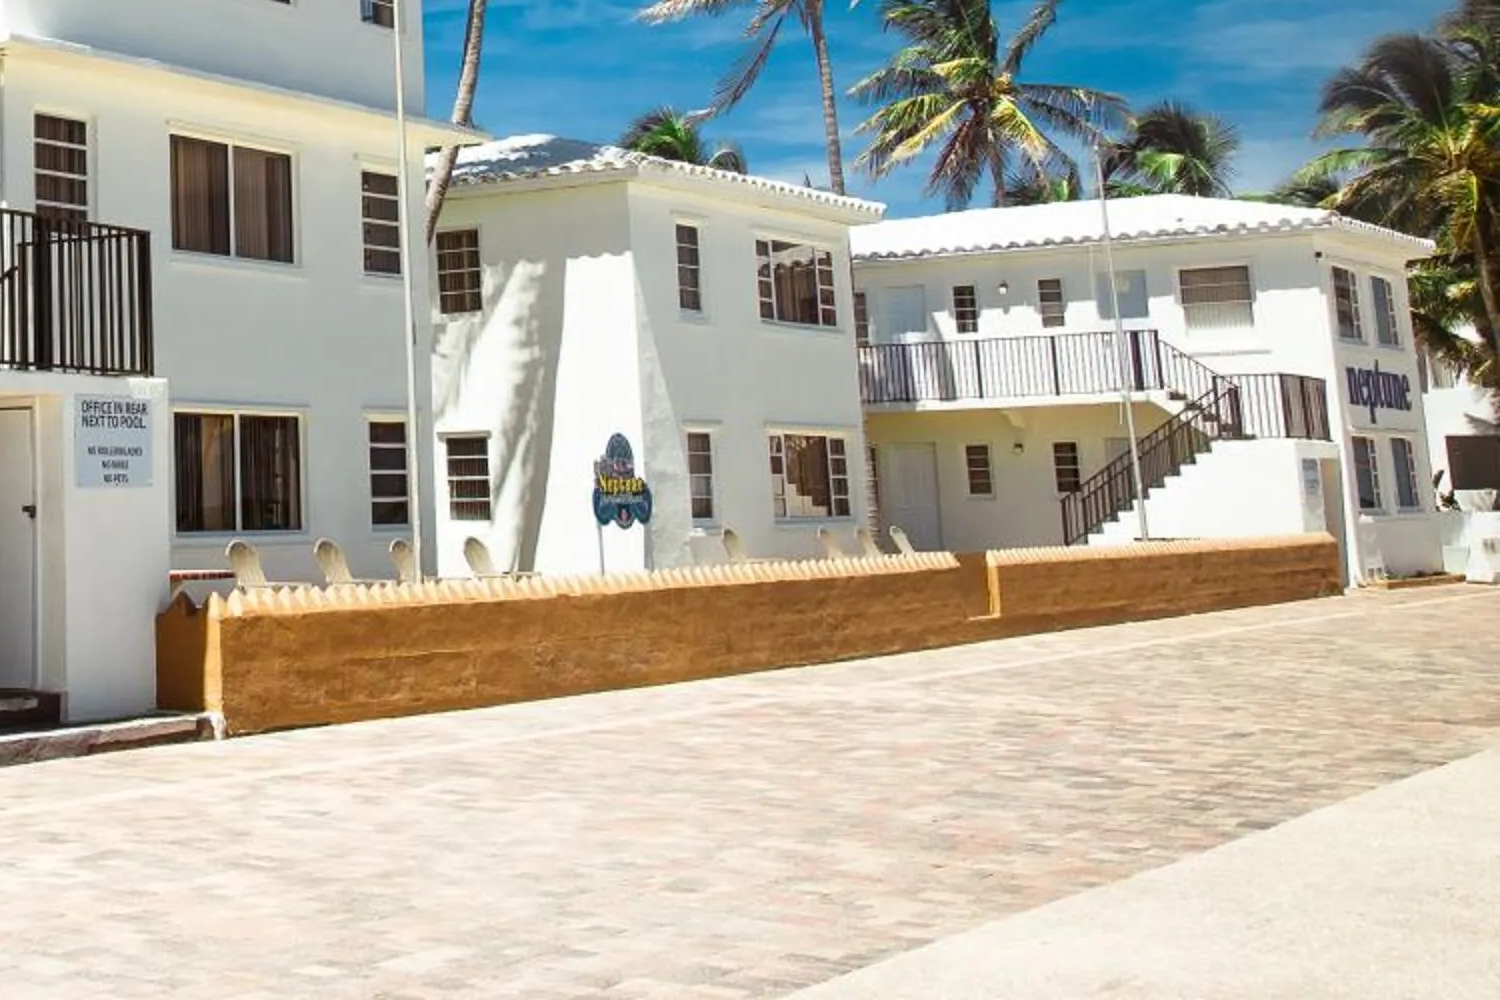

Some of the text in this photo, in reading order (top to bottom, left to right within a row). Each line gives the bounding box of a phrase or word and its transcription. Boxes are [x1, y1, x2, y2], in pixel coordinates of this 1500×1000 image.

[1345, 359, 1412, 424] neptune
[81, 399, 112, 414] OFFICE
[113, 401, 123, 415] IN
[81, 415, 106, 428] NEXT
[106, 415, 119, 428] TO
